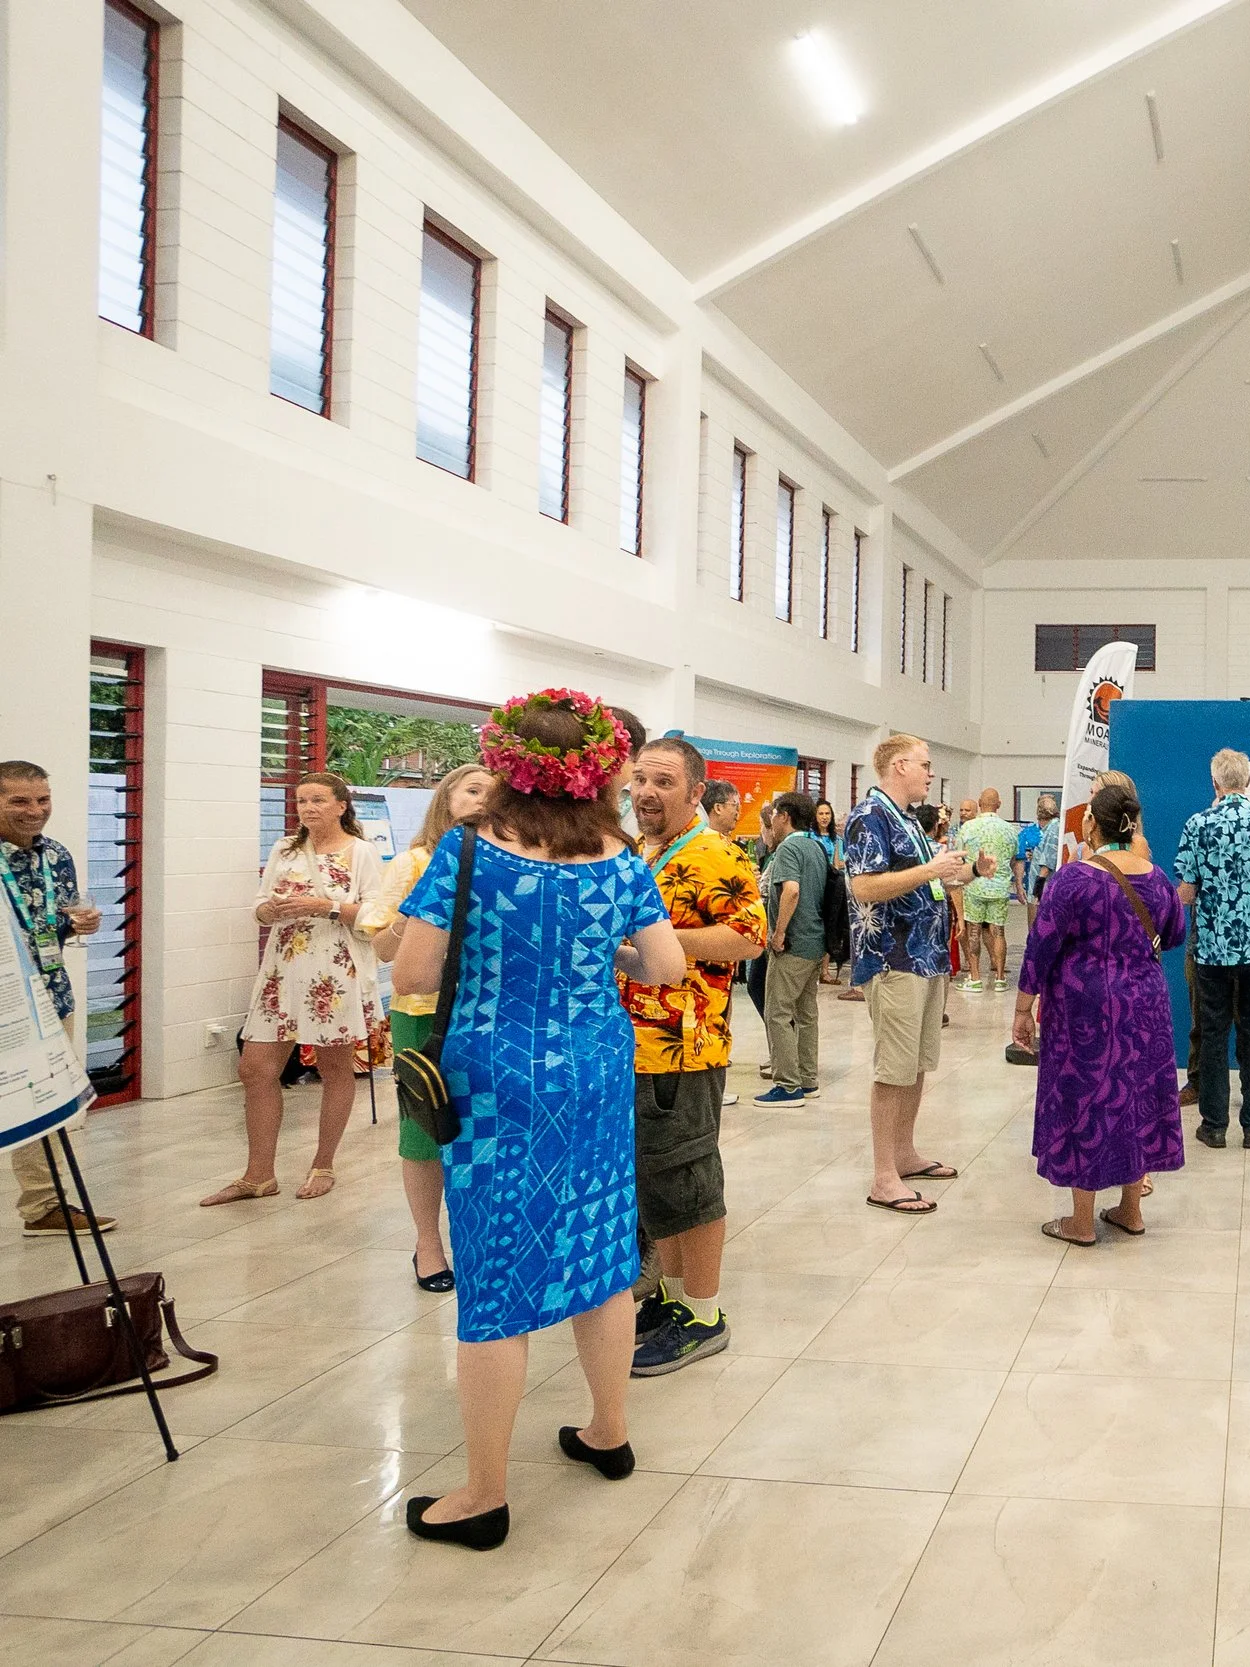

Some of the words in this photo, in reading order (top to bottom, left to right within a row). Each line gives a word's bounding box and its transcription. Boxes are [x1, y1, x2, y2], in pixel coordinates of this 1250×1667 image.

[1086, 722, 1109, 740] MOA
[1084, 737, 1109, 750] MINERAL
[701, 748, 713, 756] dge
[713, 749, 740, 758] Through
[741, 750, 782, 759] Exploration
[1079, 771, 1096, 781] Throug
